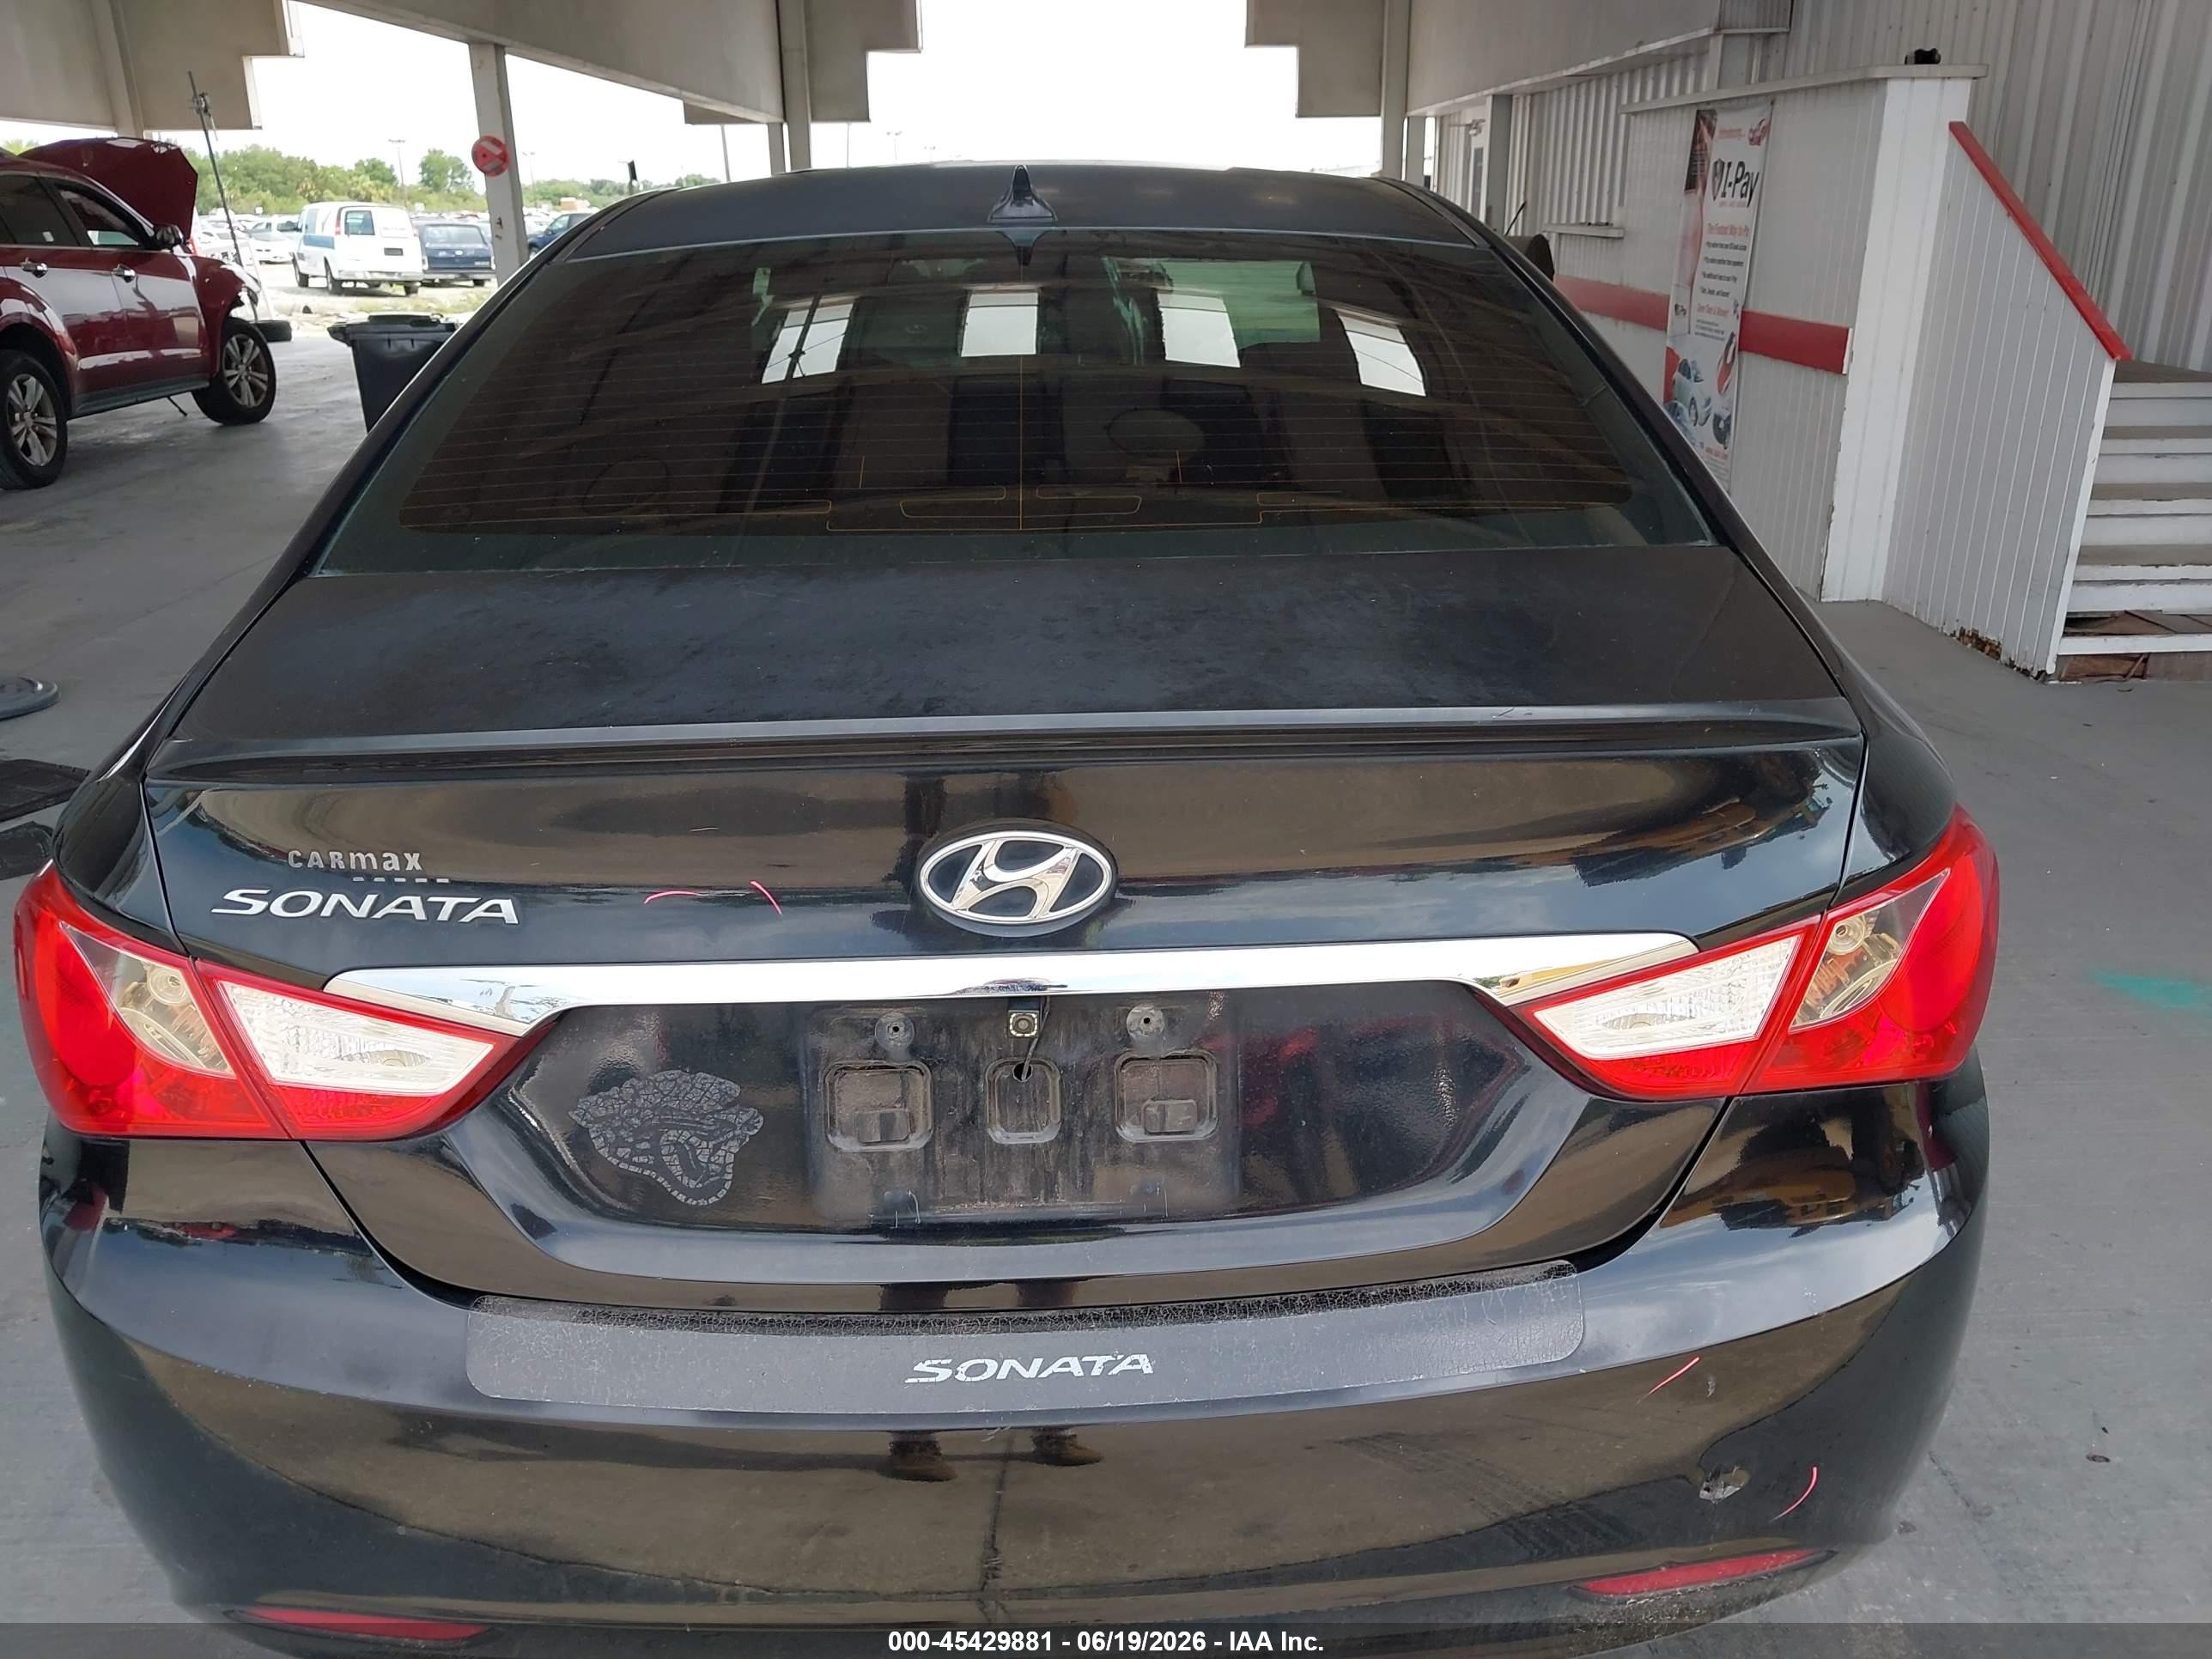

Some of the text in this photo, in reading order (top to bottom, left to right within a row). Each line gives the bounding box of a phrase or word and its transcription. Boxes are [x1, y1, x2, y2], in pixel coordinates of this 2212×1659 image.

[1720, 161, 1759, 208] I-Pay
[210, 888, 520, 925] SONATA
[904, 1353, 1154, 1383] SONATA
